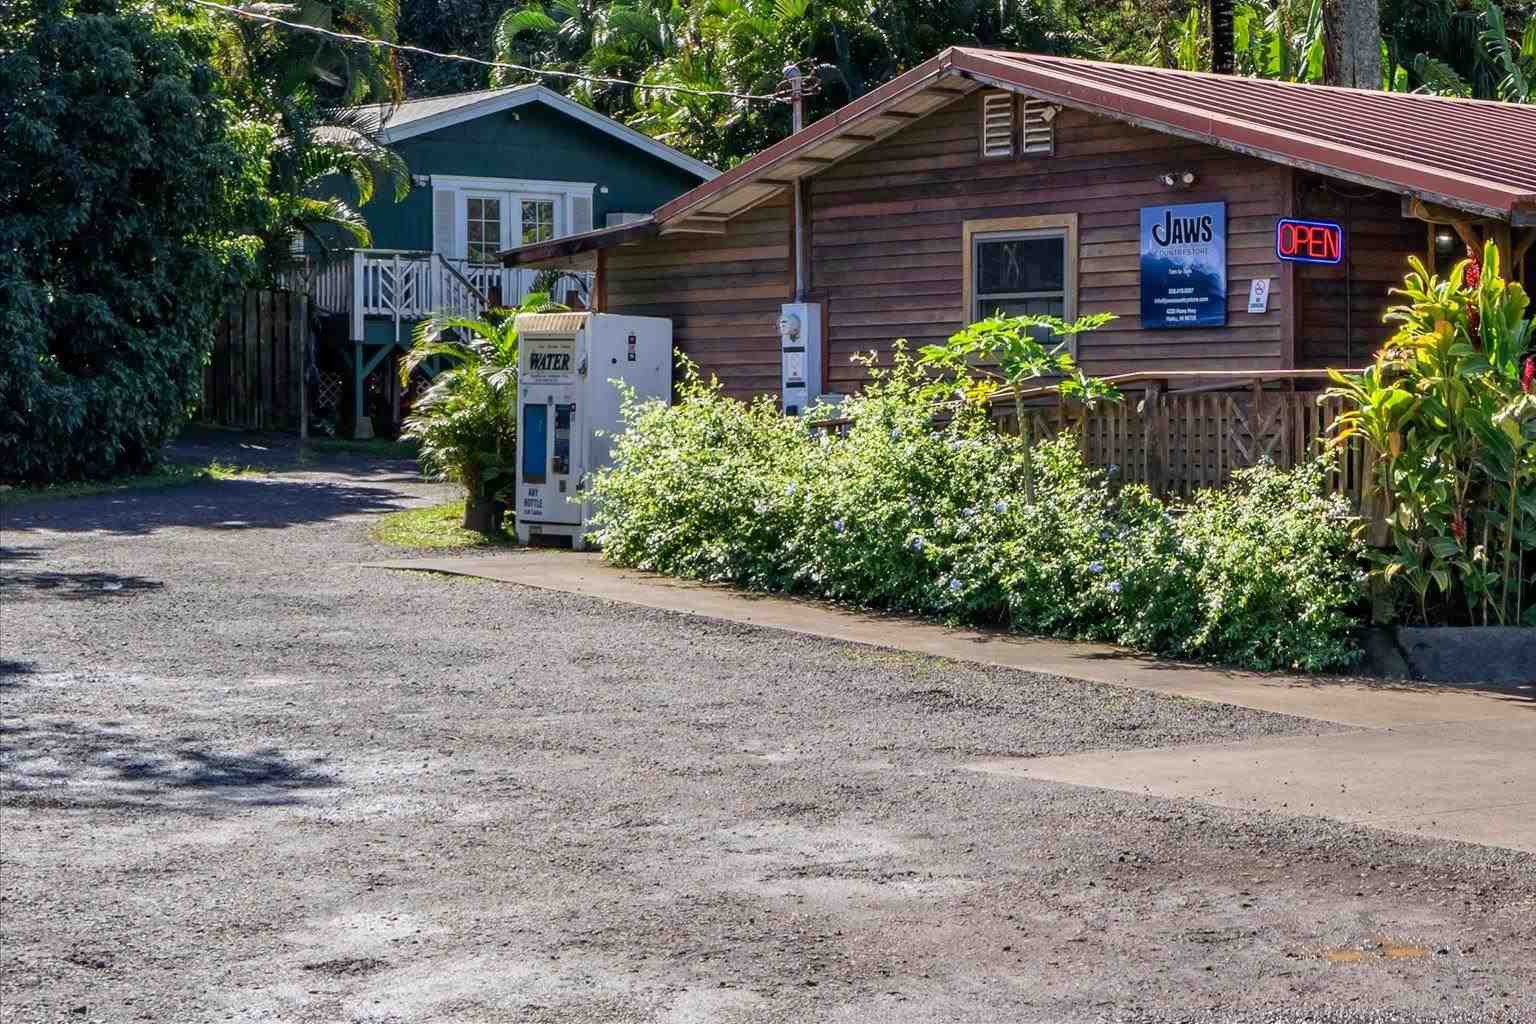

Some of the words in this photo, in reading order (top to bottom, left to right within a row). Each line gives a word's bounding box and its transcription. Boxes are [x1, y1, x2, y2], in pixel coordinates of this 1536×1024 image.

[1152, 210, 1213, 246] JAWS
[1280, 224, 1339, 257] OPEN
[530, 352, 570, 371] WATER
